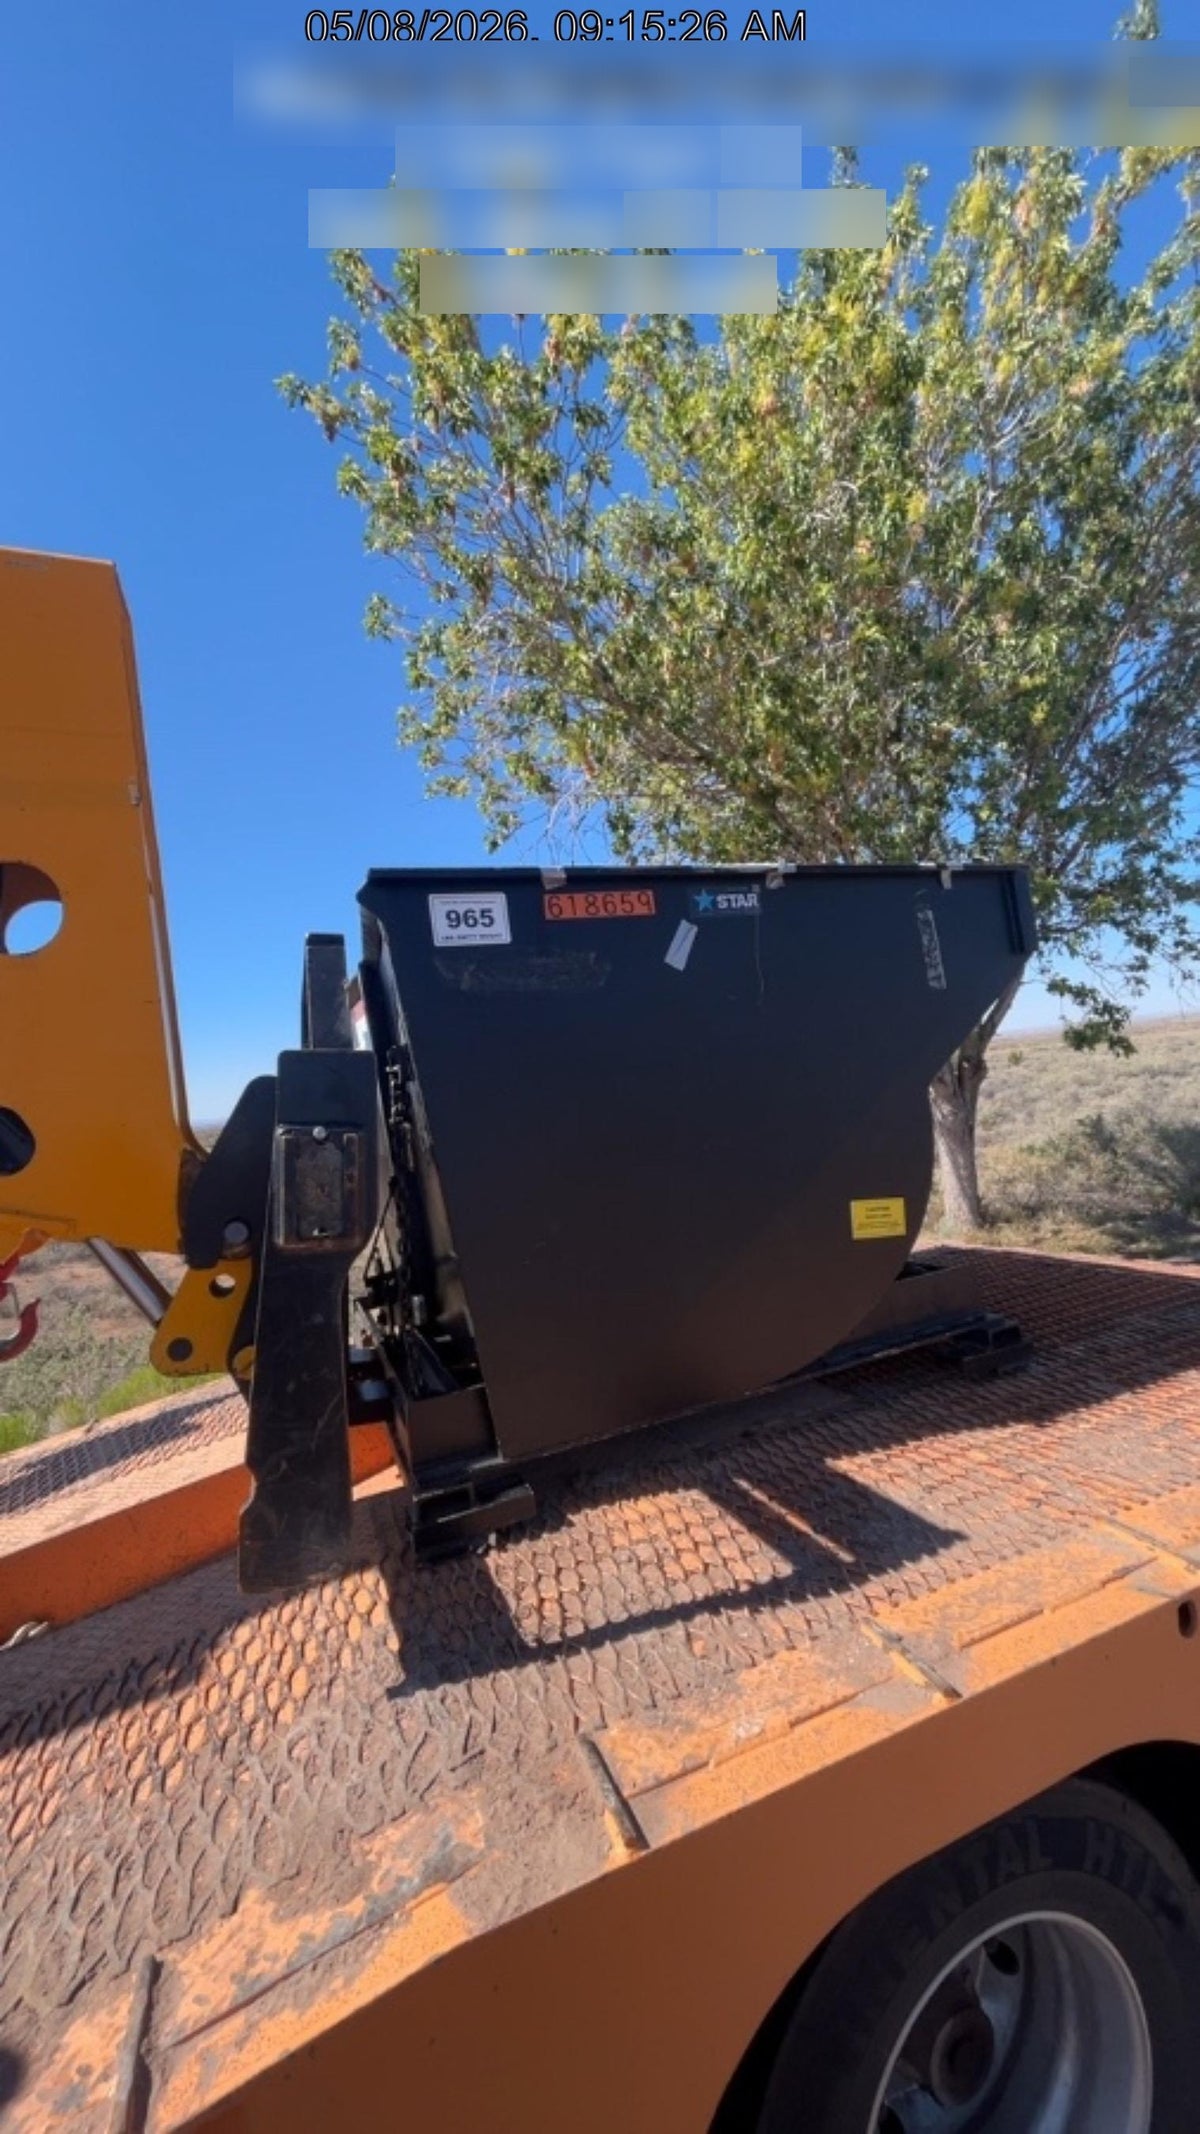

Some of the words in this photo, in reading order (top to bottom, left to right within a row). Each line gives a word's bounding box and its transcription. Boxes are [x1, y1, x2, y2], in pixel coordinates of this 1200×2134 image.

[547, 891, 652, 917] 618659
[716, 893, 759, 909] STAR
[445, 907, 495, 929] 965
